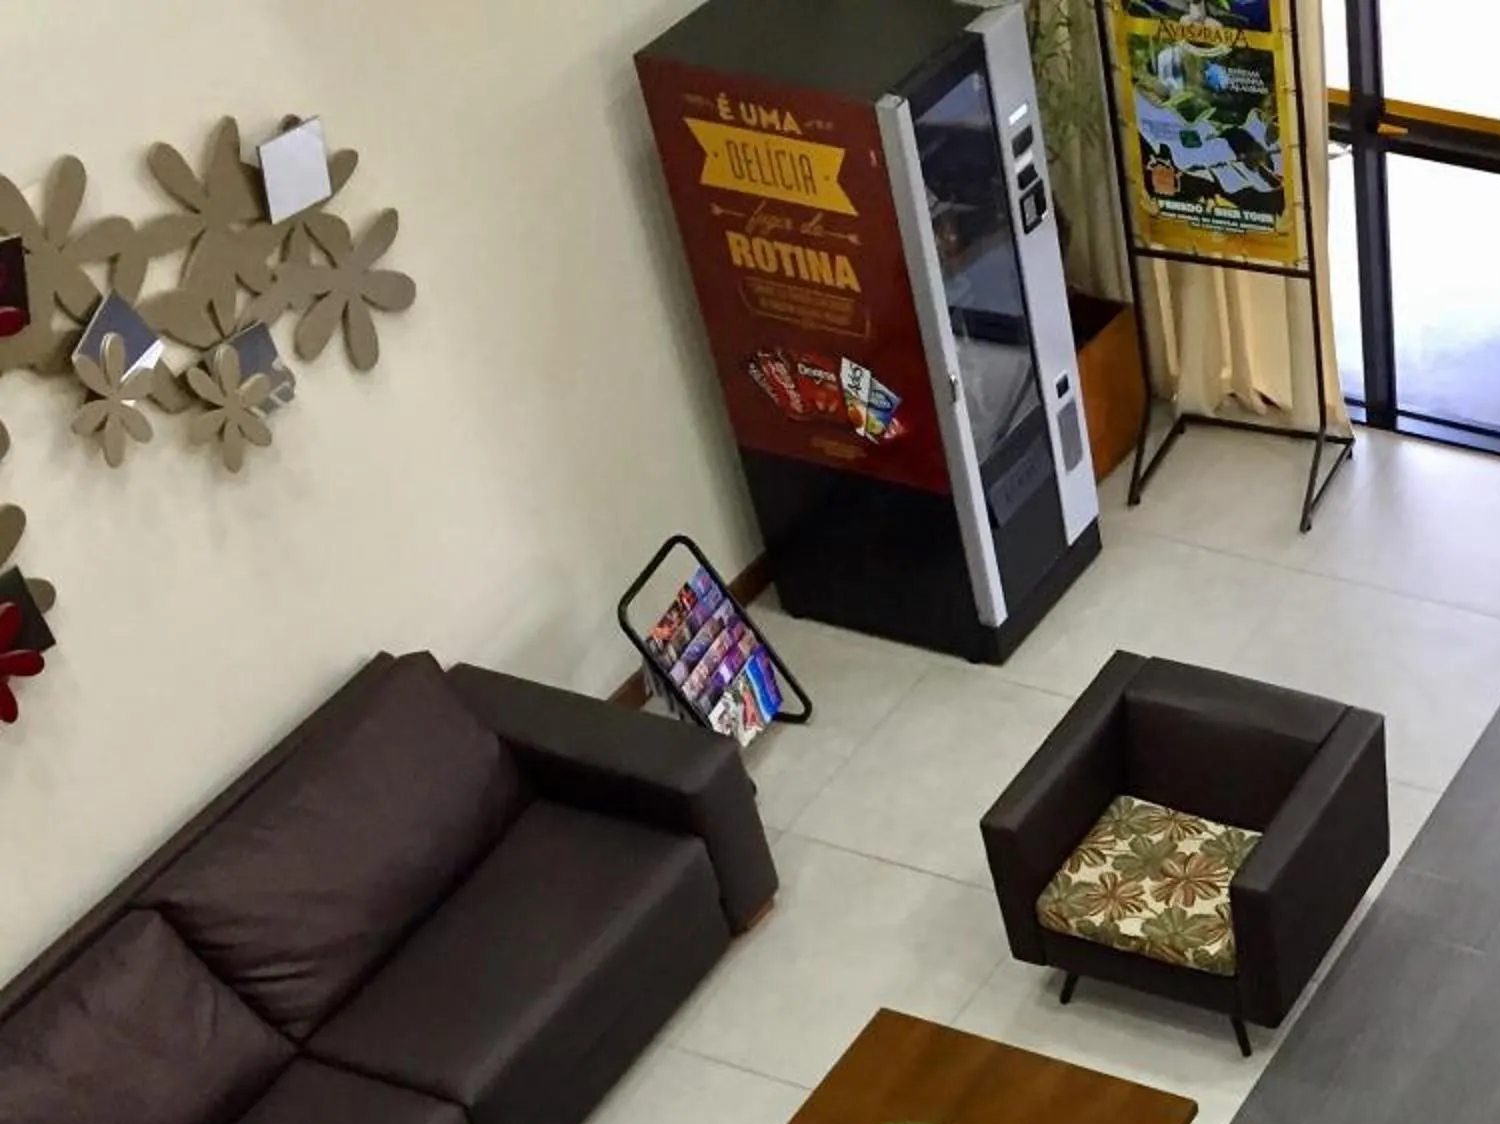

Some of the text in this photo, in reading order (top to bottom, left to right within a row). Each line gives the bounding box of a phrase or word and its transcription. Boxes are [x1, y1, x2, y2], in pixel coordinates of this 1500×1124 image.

[716, 91, 803, 135] É UMA
[725, 138, 818, 197] DELÍCIA
[724, 229, 862, 294] ROTINA
